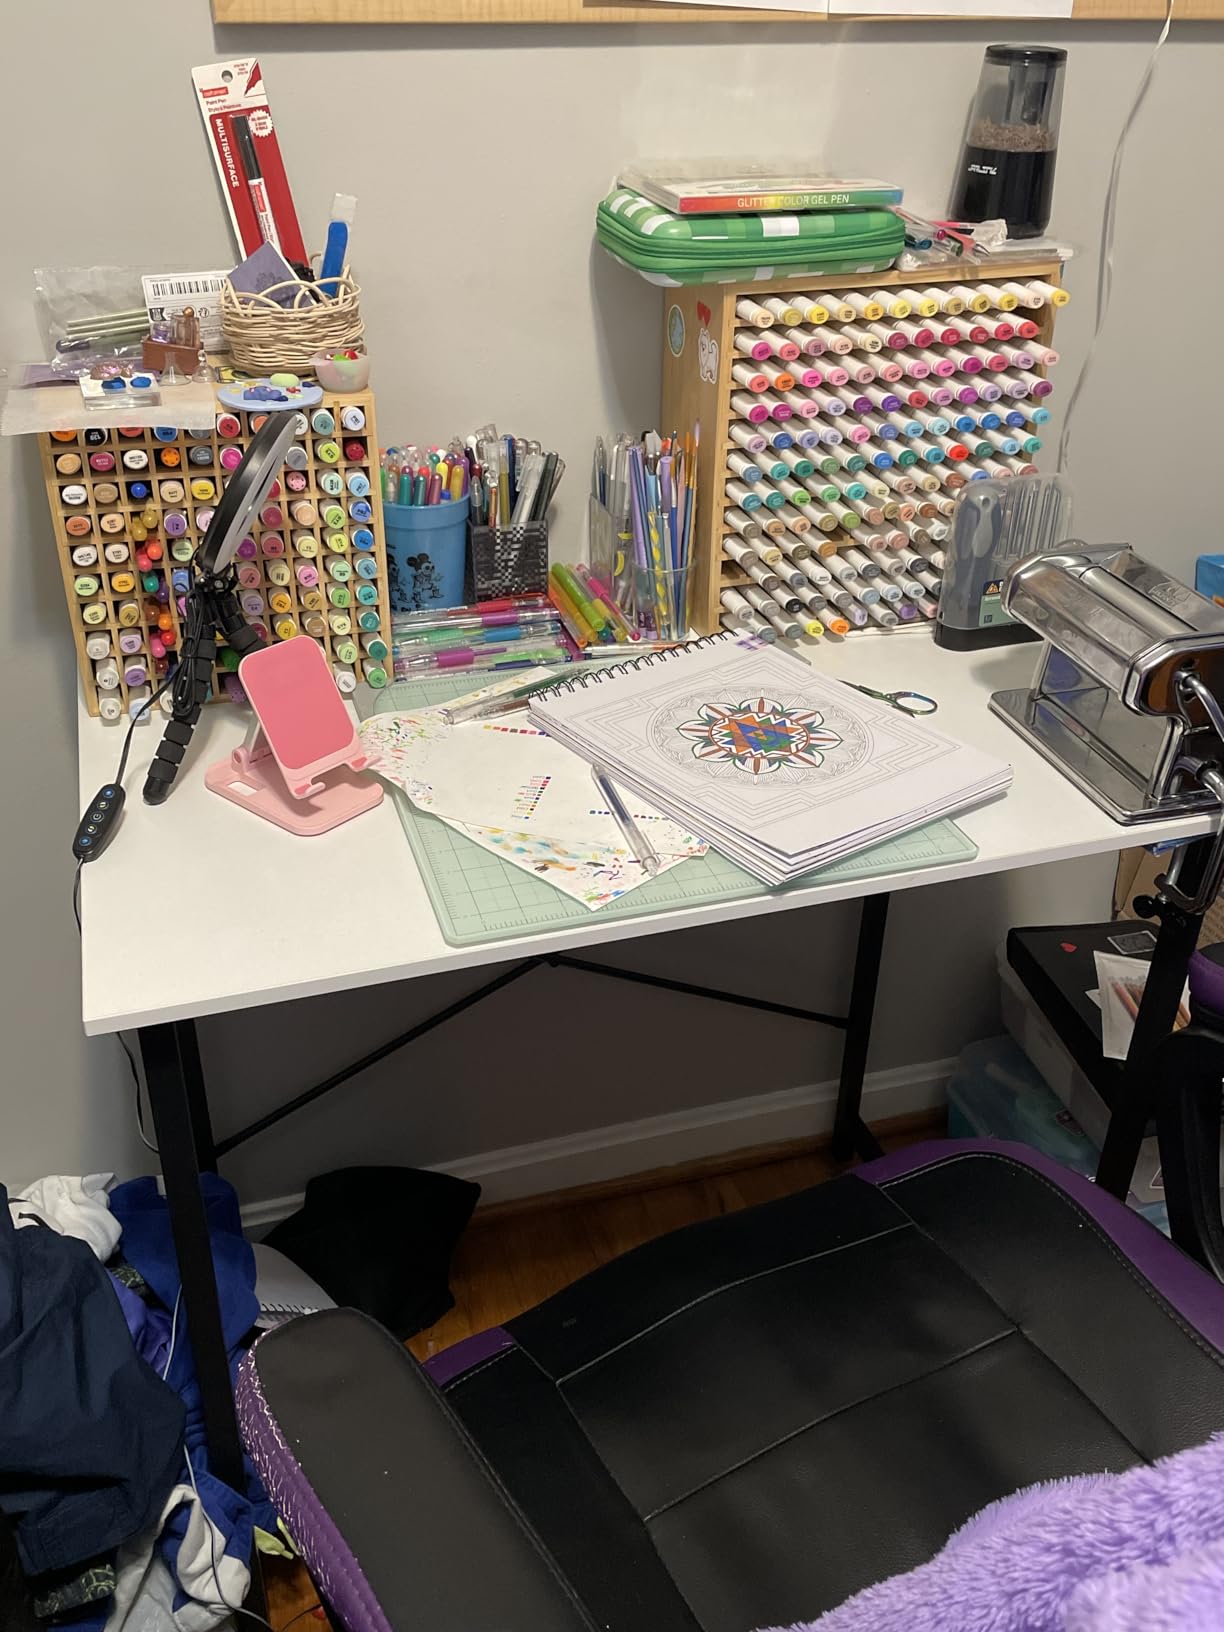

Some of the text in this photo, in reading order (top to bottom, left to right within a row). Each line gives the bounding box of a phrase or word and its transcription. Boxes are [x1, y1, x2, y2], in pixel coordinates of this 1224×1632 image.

[215, 118, 239, 187] MULTISURFACE
[811, 194, 828, 205] GEL
[831, 193, 850, 204] PEN
